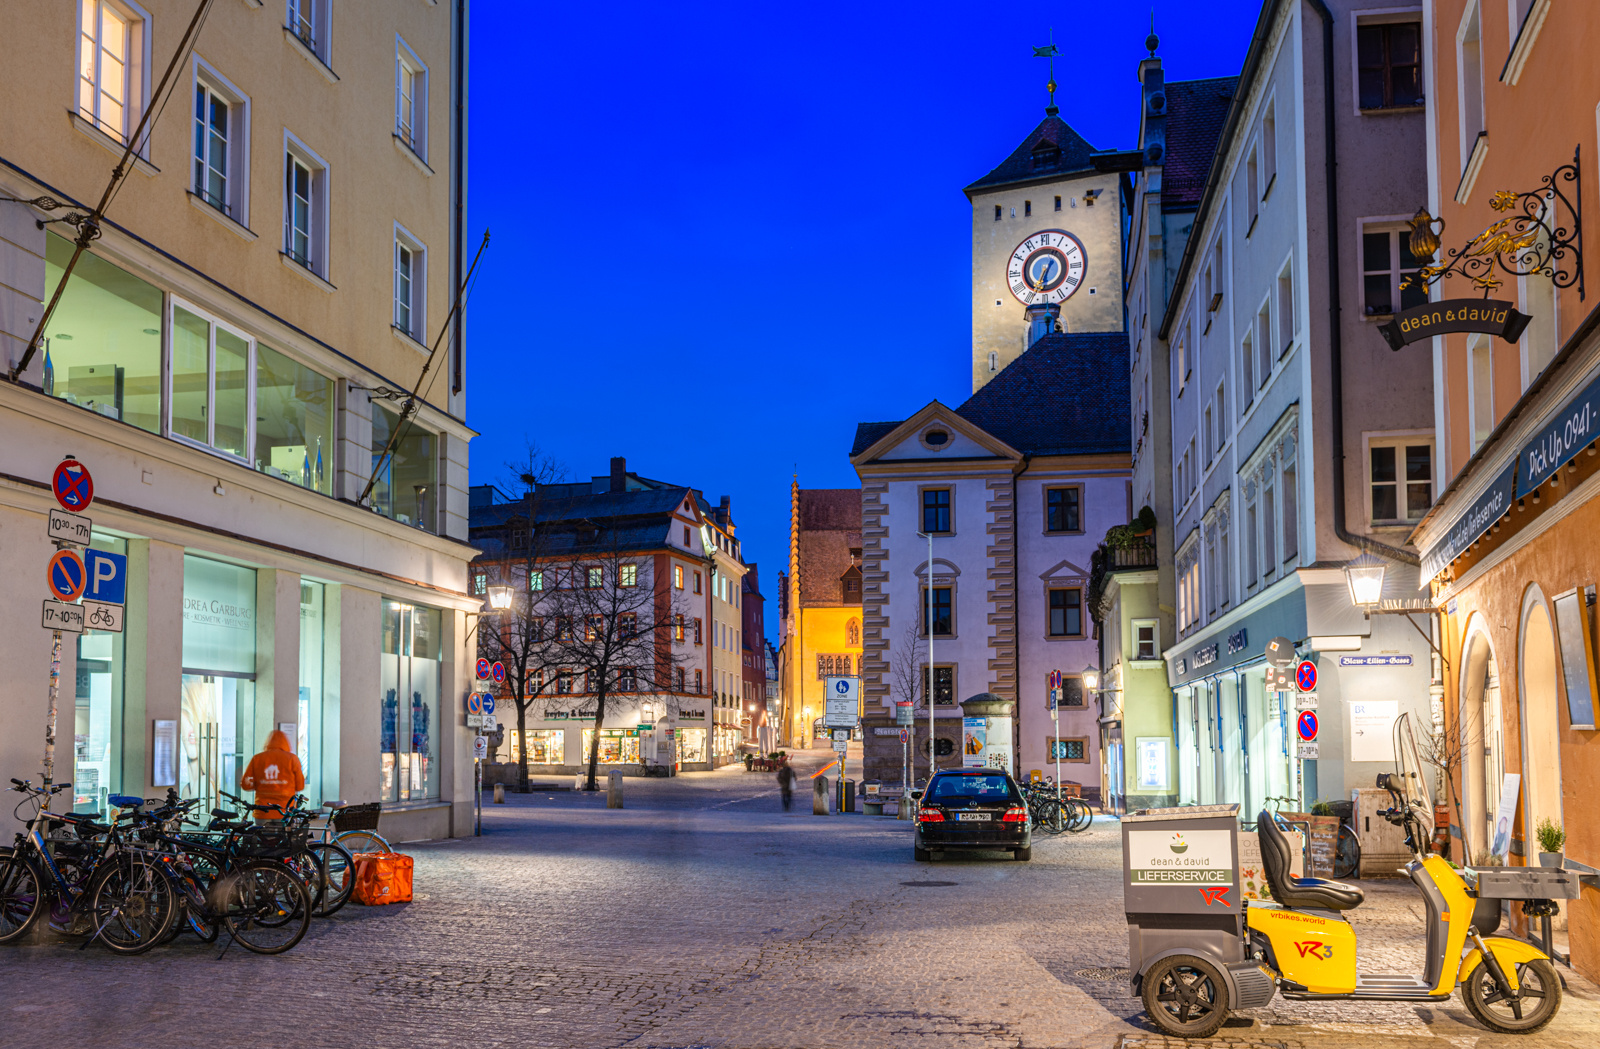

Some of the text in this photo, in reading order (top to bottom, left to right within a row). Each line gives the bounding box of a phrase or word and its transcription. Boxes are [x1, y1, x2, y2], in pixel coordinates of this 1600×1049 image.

[1400, 307, 1508, 332] dean & david
[1529, 440, 1547, 480] Pick
[1550, 431, 1562, 467] Up
[1564, 402, 1590, 449] 0941
[93, 556, 117, 594] P
[210, 600, 252, 619] GARBURG
[194, 614, 220, 624] KOSMETIK
[1355, 705, 1365, 714] BR
[1184, 858, 1209, 866] david
[1138, 871, 1225, 881] LIEFERSERVICE
[1270, 913, 1325, 925] vrbikes.world
